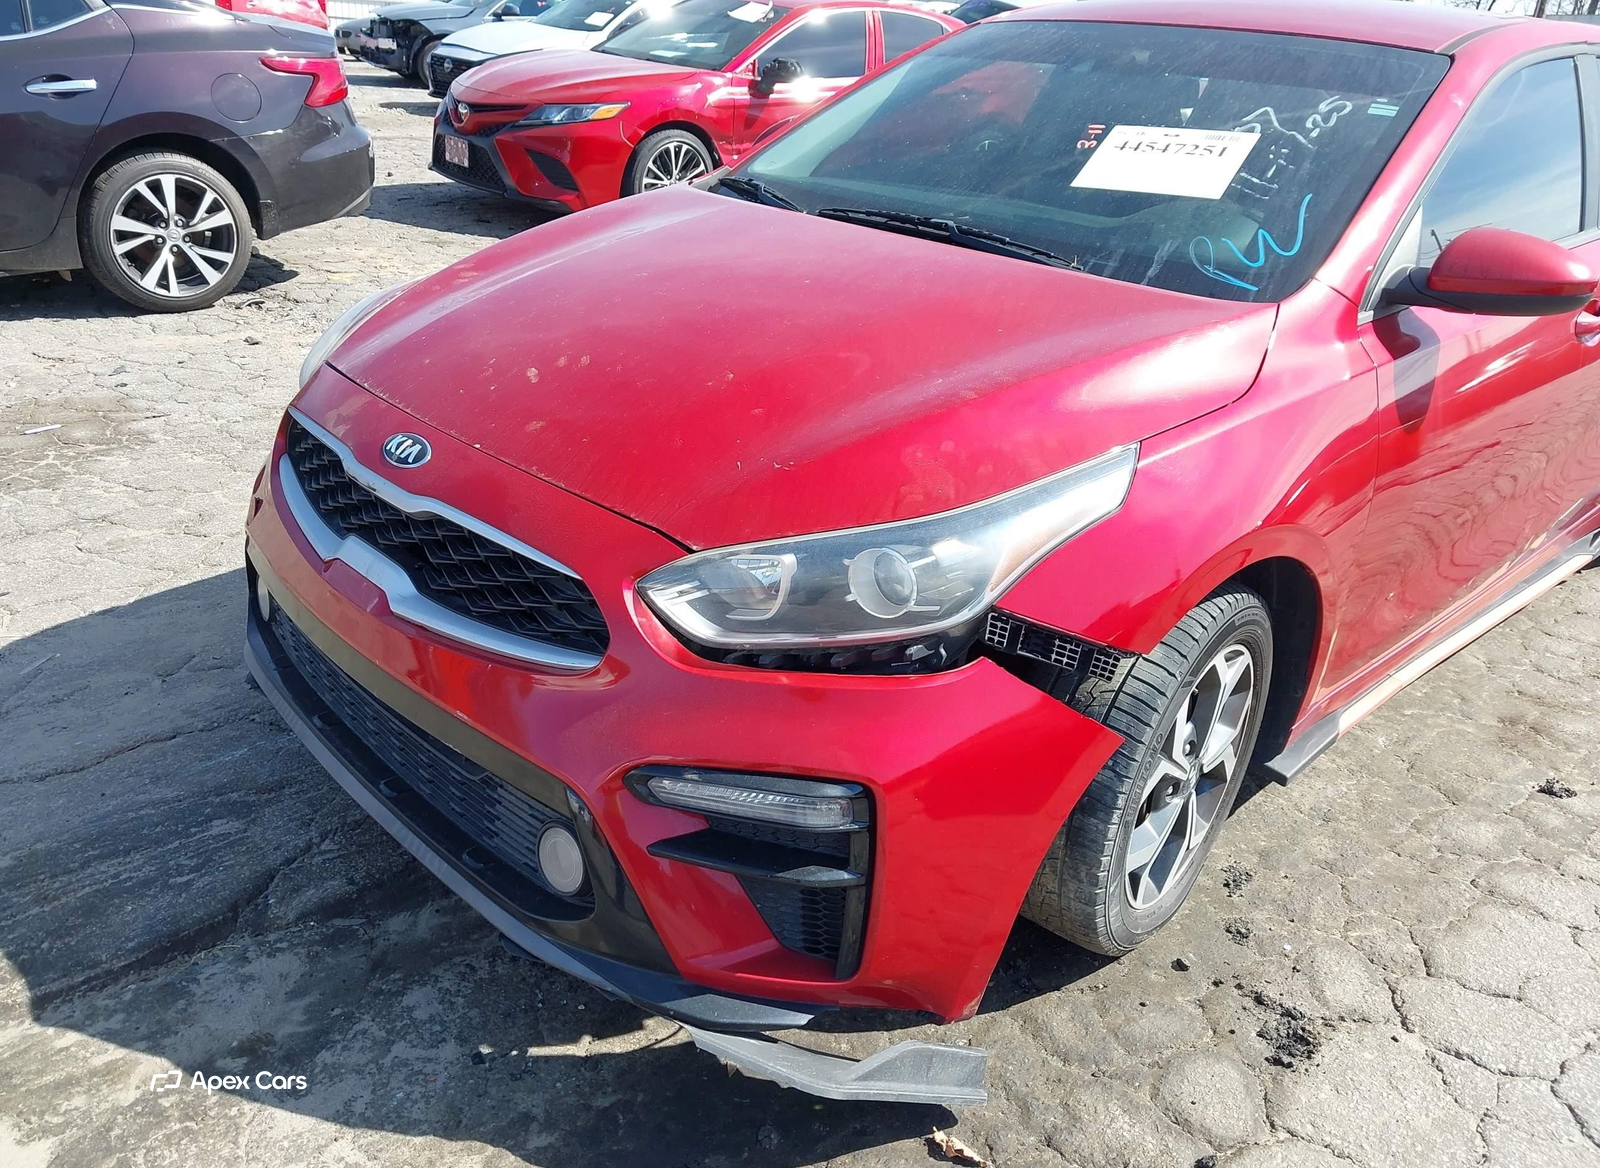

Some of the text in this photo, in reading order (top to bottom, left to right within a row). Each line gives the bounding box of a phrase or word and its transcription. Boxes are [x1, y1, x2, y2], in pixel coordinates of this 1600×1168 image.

[1076, 124, 1107, 149] 3-11
[1114, 139, 1228, 157] 44547251
[385, 434, 423, 464] KIA
